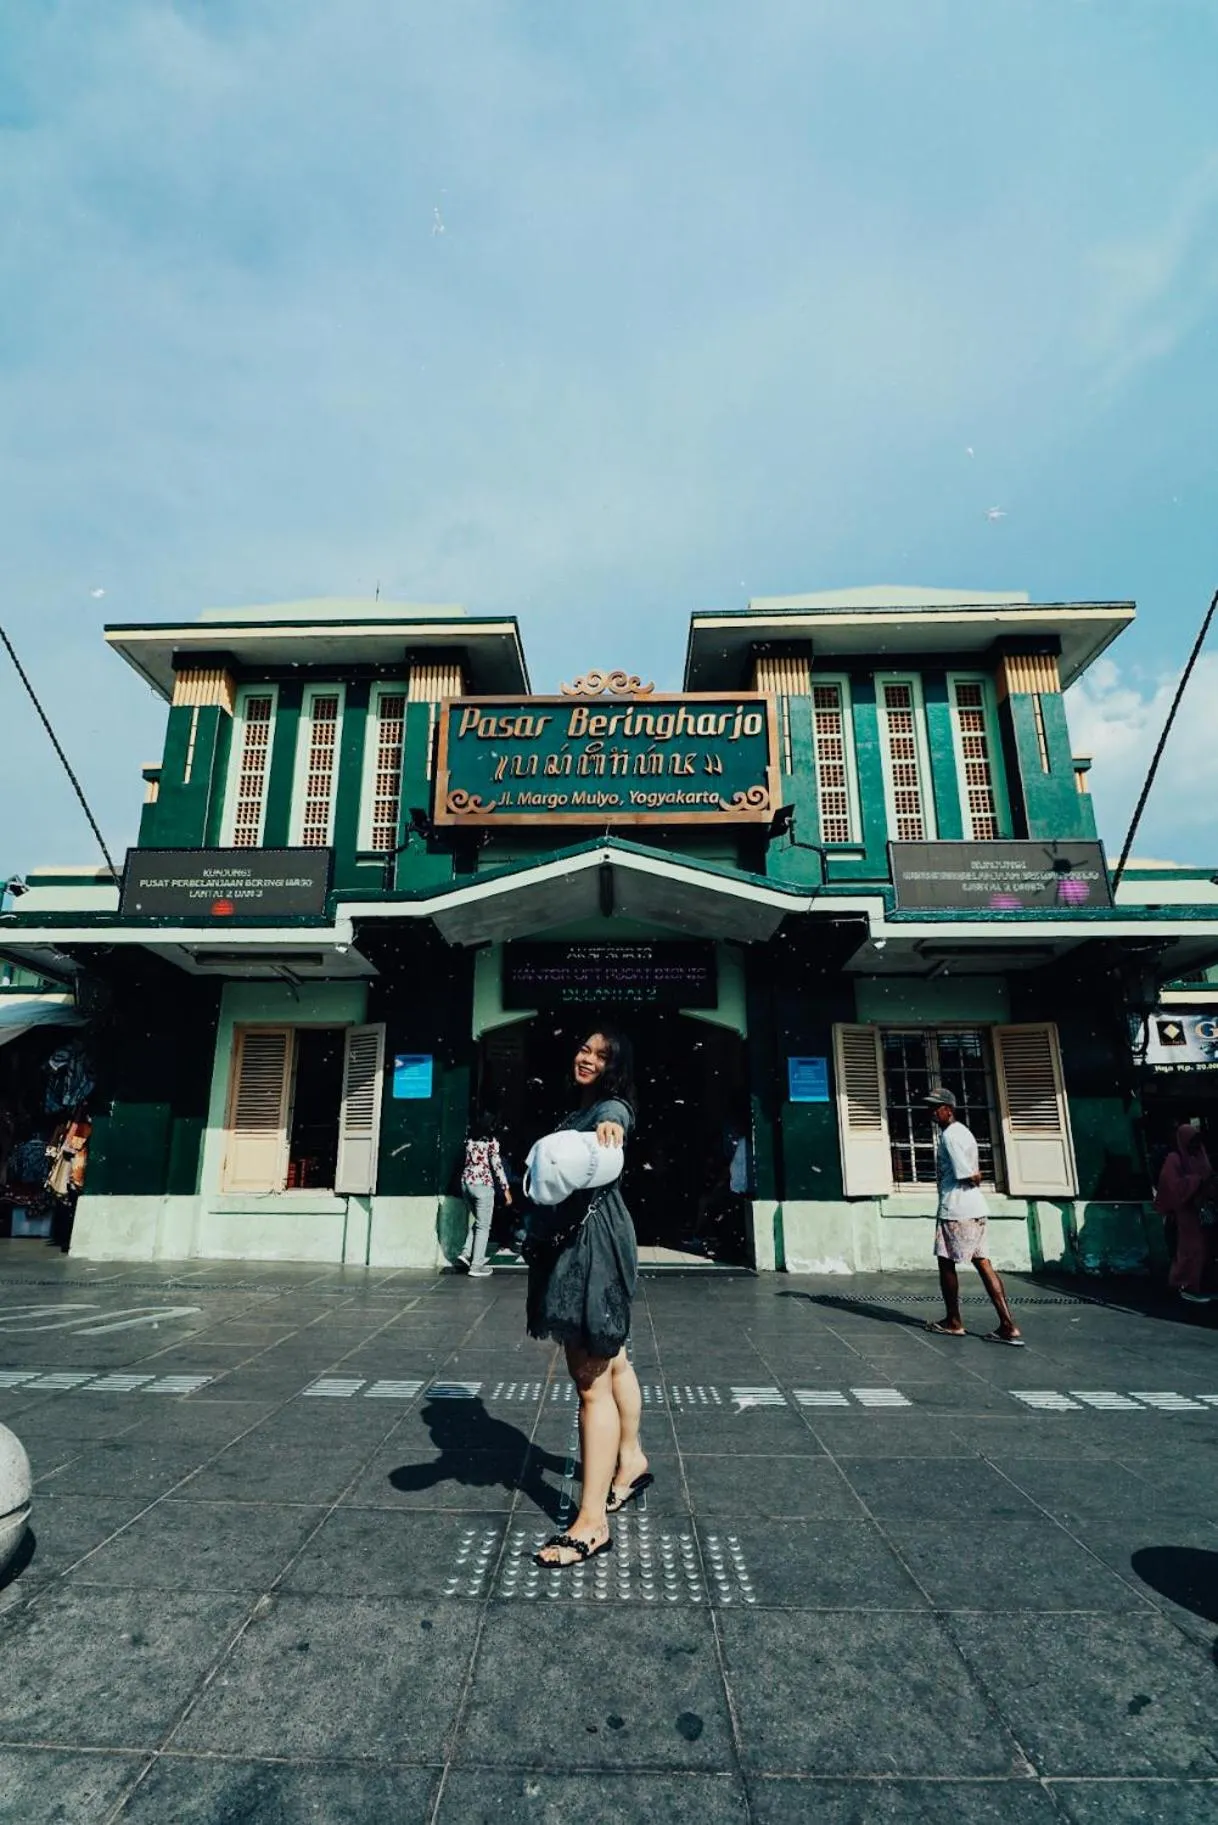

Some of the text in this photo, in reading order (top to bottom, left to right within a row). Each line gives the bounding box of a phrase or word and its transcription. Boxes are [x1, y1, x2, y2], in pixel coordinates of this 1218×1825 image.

[458, 705, 763, 740] Pasar Beringharjo
[498, 790, 719, 808] Jl. Margo Mulyo, Yogyakarta
